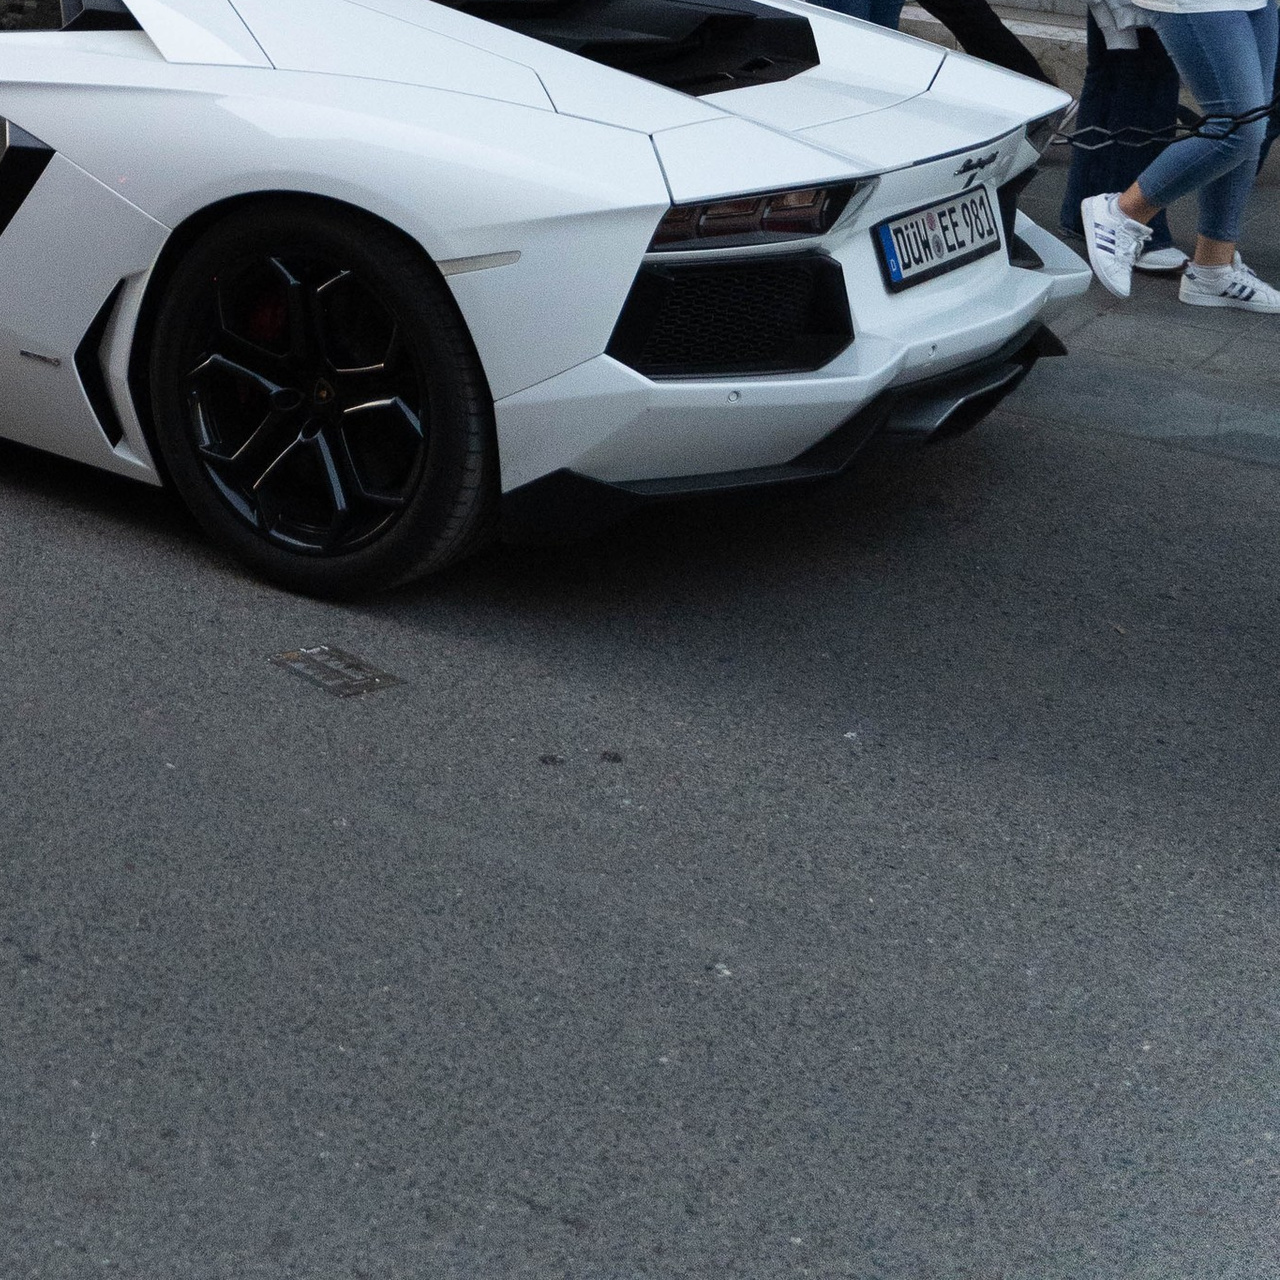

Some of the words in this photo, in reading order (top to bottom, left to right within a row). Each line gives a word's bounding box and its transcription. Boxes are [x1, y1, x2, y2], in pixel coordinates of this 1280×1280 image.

[893, 218, 934, 270] DÜW
[937, 206, 966, 253] EE
[961, 195, 994, 243] 981
